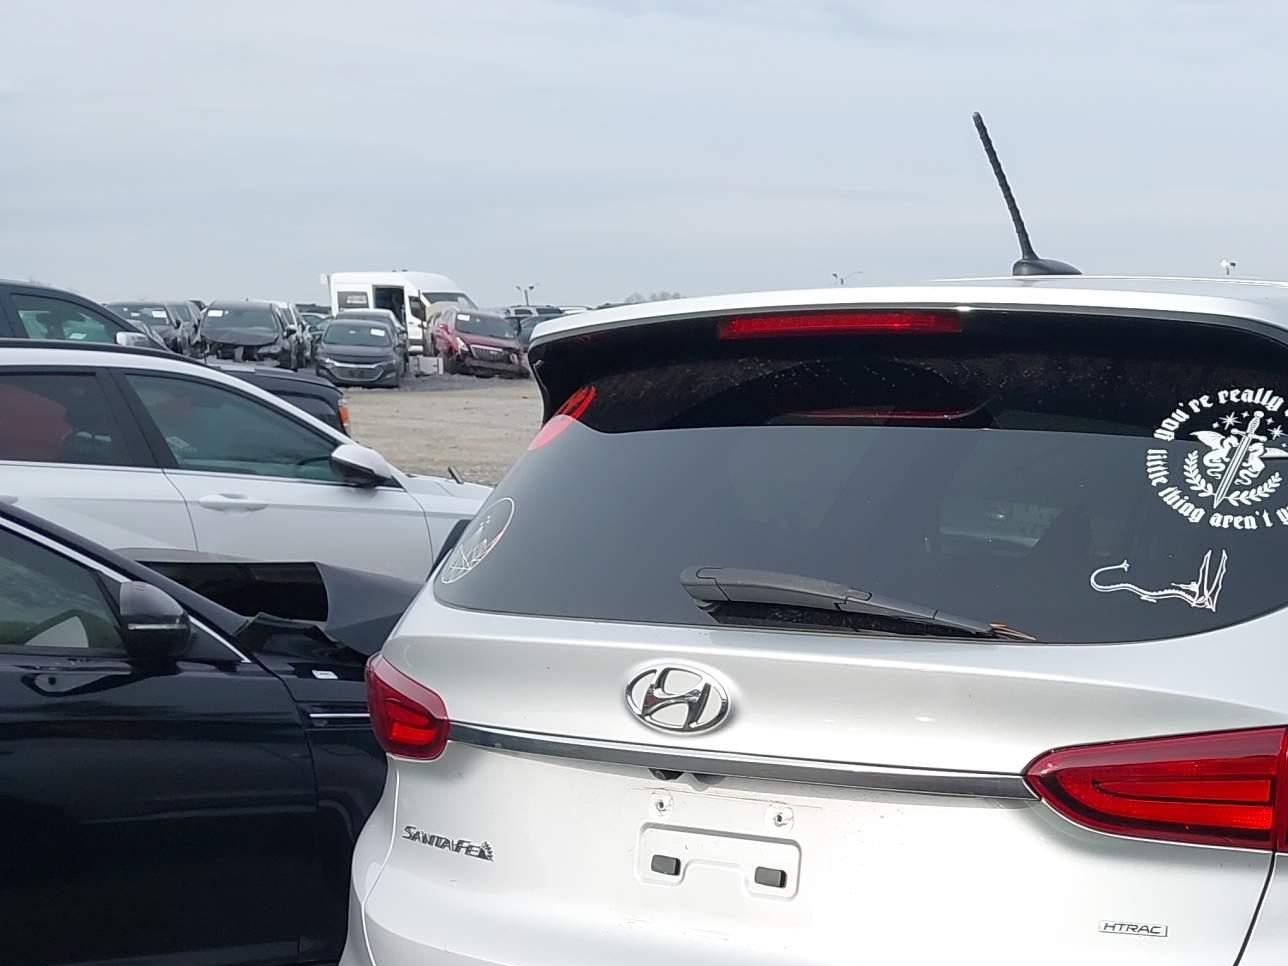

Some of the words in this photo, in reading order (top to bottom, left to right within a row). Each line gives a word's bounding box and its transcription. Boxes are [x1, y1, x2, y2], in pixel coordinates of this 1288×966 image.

[1217, 388, 1284, 411] really
[1154, 394, 1213, 441] you're
[1146, 449, 1169, 486] little
[1158, 486, 1205, 522] thing
[1210, 510, 1273, 530] aren't
[1104, 922, 1162, 934] HTRAC
